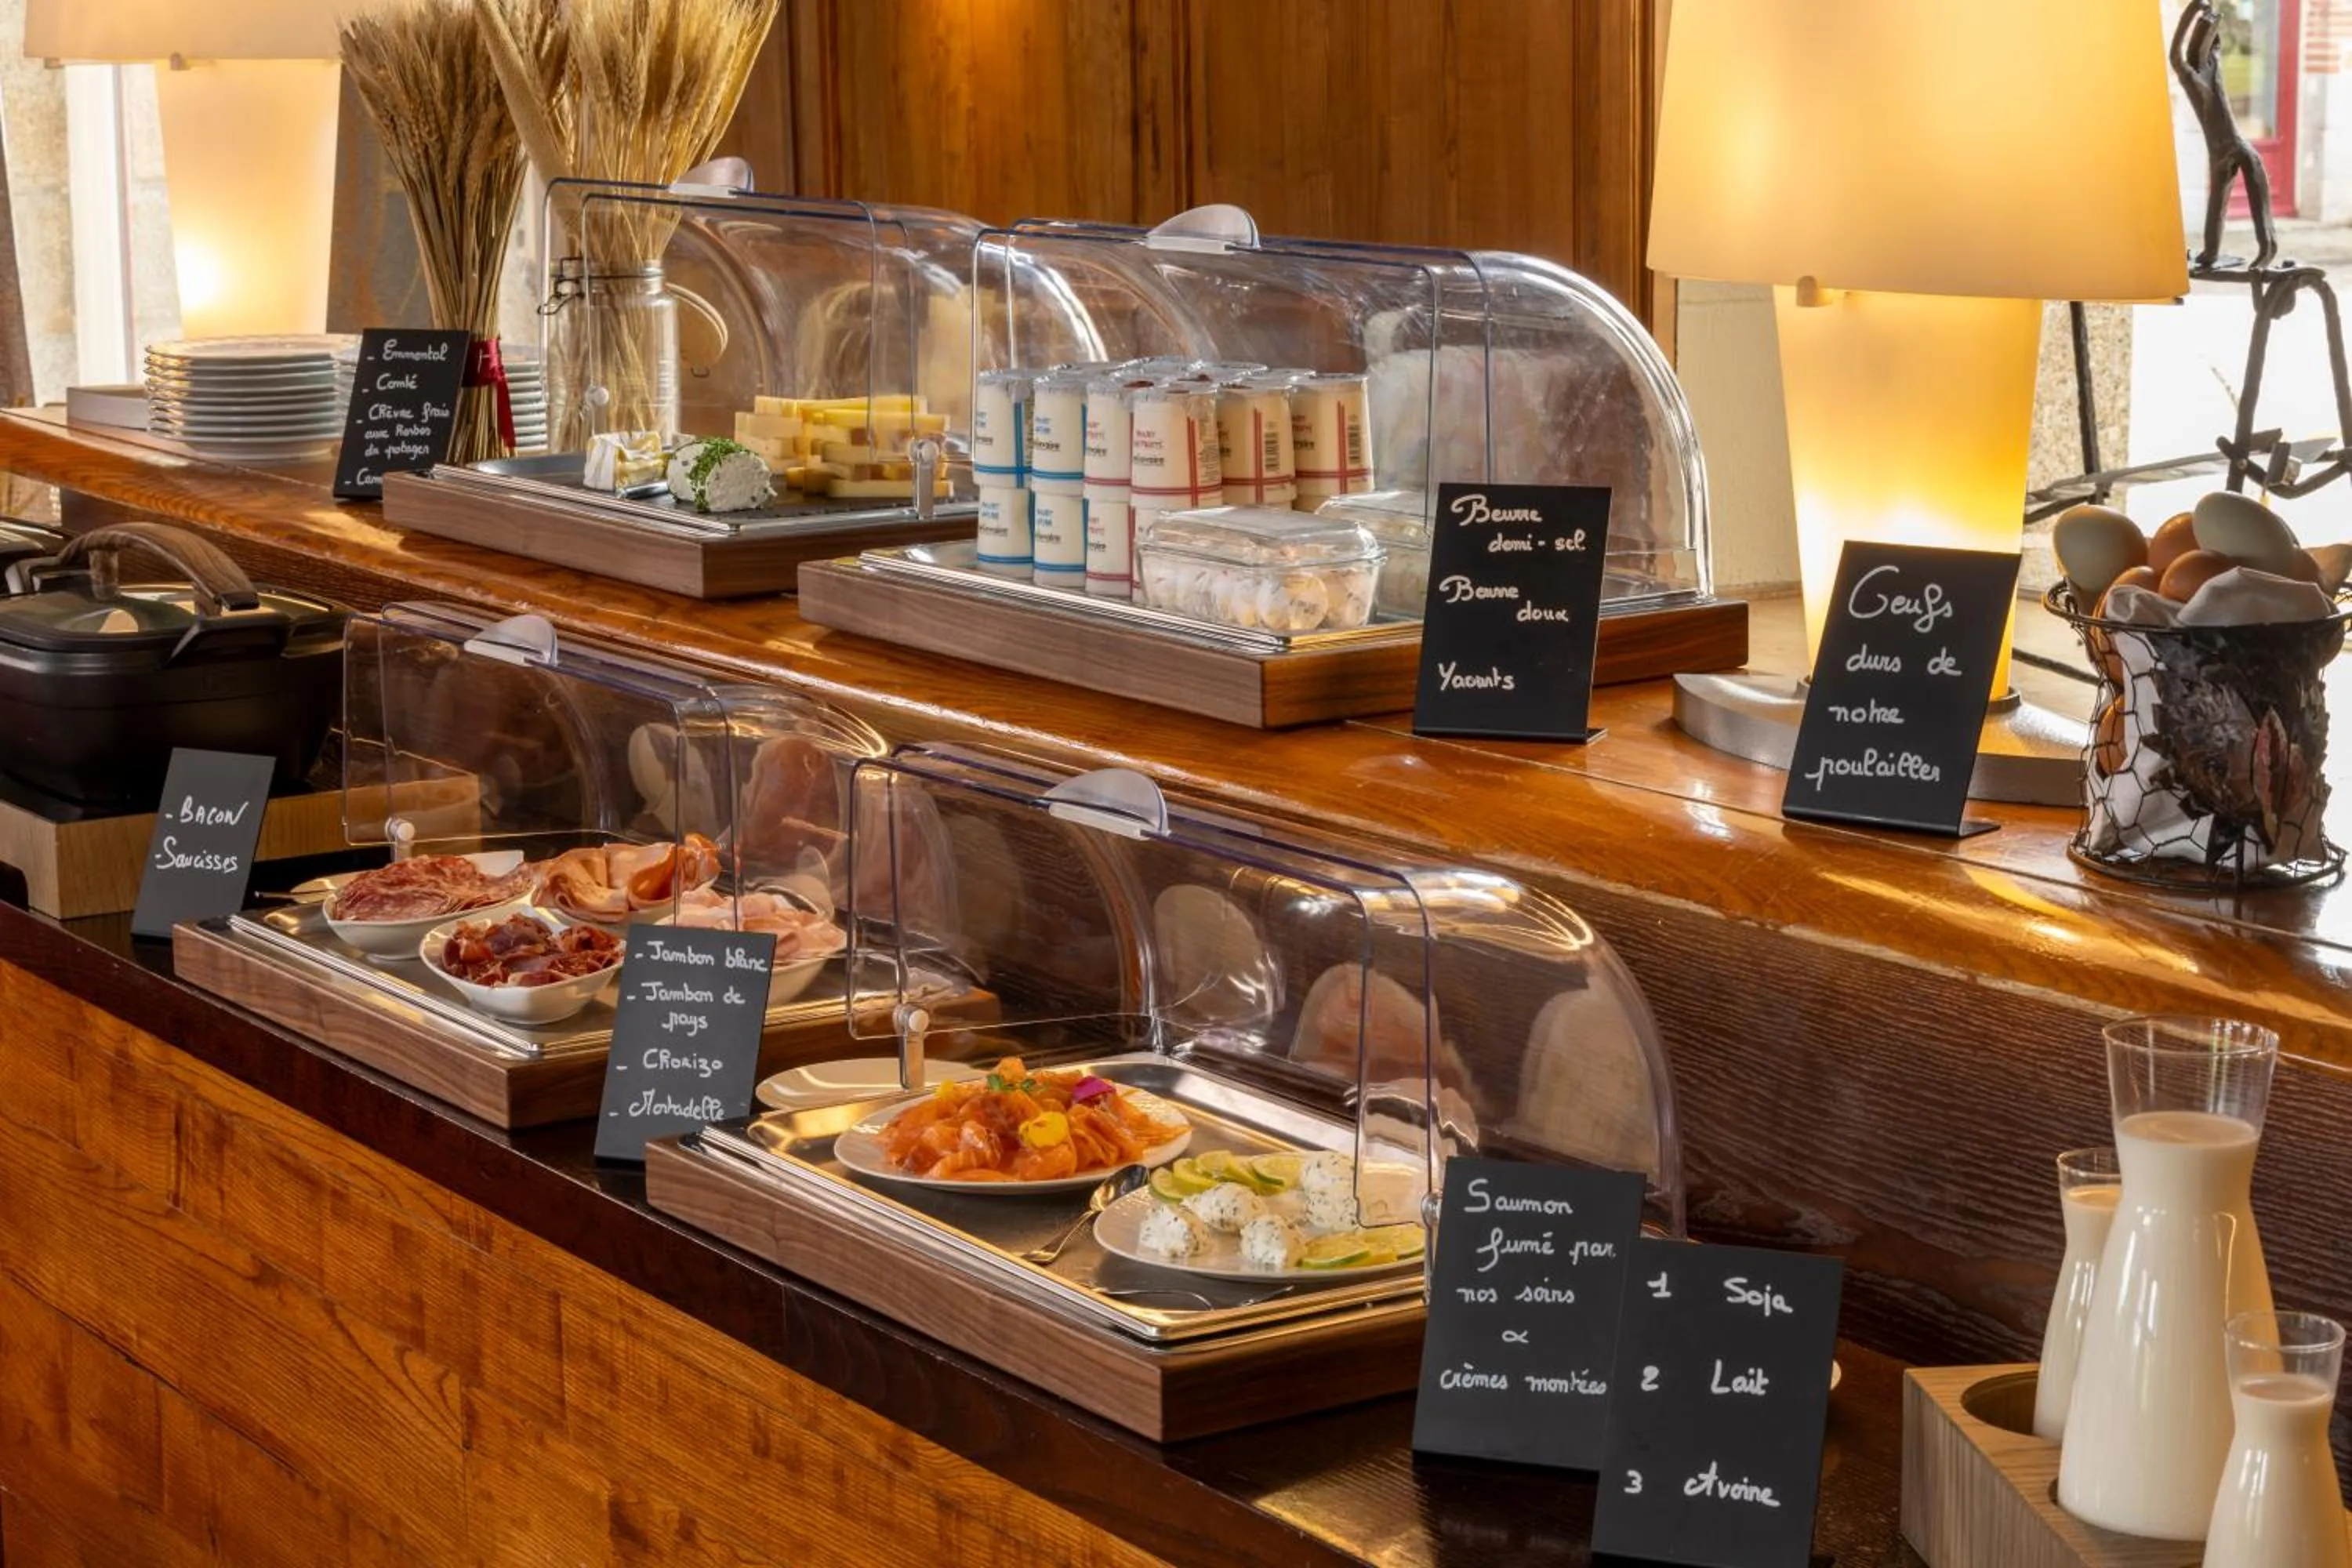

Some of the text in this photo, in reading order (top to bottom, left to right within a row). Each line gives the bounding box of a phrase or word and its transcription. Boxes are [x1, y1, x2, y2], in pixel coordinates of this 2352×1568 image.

[383, 339, 448, 361] Emmental
[376, 373, 416, 390] Comté
[422, 401, 449, 423] frais
[1517, 601, 1568, 622] doux
[1846, 644, 1962, 676] durs de
[1439, 662, 1514, 690] Yaourts
[1805, 749, 1940, 791] poulailler
[180, 796, 249, 825] BACON
[648, 941, 768, 971] Jambon blanc
[641, 982, 745, 1004] Jambon de
[662, 1012, 708, 1036] pays
[1465, 1178, 1573, 1214] Saumon
[1477, 1228, 1554, 1272] fumé
[1457, 1278, 1574, 1303] nos soins
[1647, 1272, 1793, 1316] 1 Soja
[1525, 1370, 1606, 1394] montées
[1641, 1359, 1769, 1395] 2 Lait
[1624, 1461, 1780, 1507] 3 Avoine
